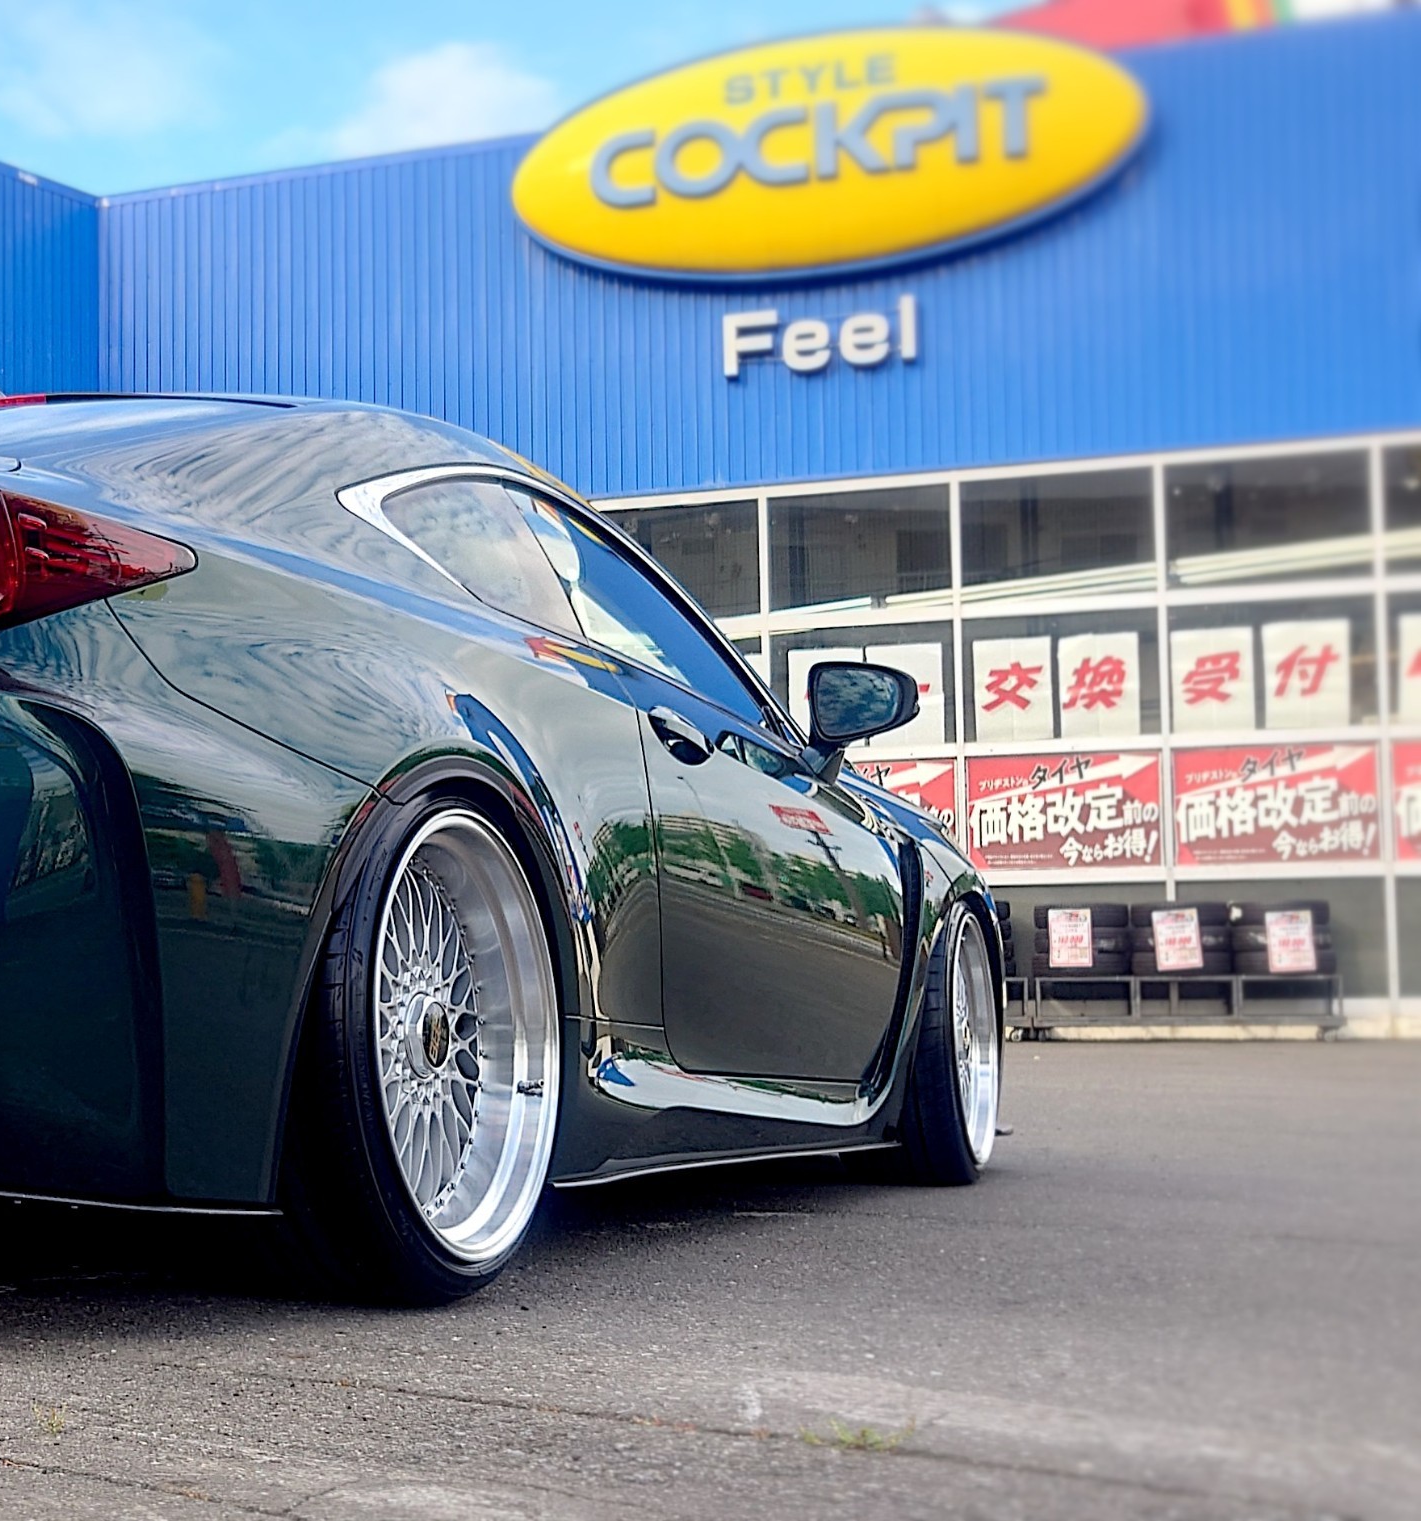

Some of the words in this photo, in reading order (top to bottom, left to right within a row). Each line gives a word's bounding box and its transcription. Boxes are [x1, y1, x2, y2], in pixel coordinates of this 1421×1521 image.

[724, 54, 898, 105] STYLE
[589, 75, 1048, 210] COCKPIT
[722, 295, 916, 379] Feel
